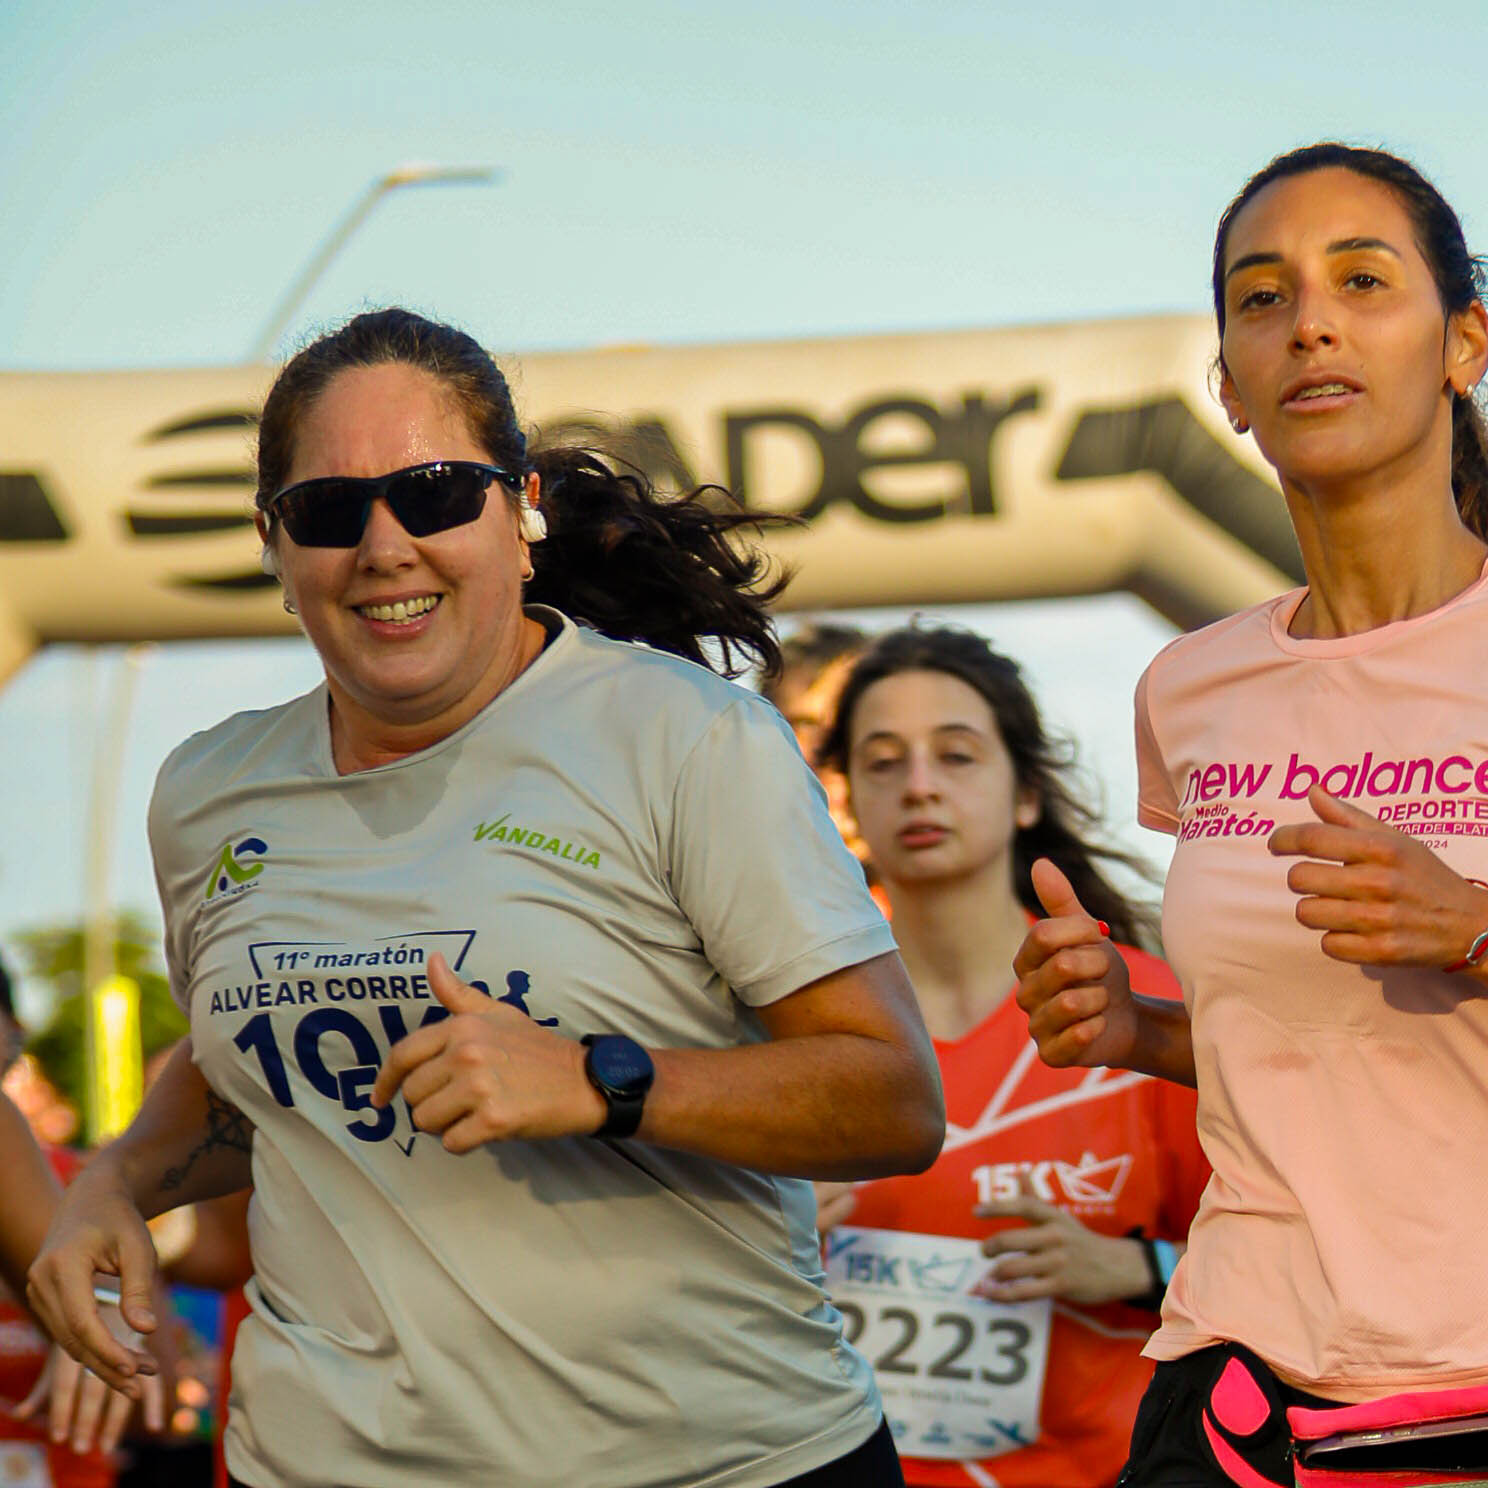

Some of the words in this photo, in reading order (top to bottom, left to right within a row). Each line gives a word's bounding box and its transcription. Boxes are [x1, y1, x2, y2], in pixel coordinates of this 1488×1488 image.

[1183, 762, 1272, 807] new
[1195, 804, 1229, 818] Medio
[474, 813, 601, 869] VANDALIA
[1424, 825, 1451, 834] DEL
[273, 951, 309, 971] 11°
[314, 943, 424, 968] maratón
[210, 980, 318, 1015] ALVEAR
[325, 974, 430, 1002] CORRE
[845, 1253, 899, 1286] 15K
